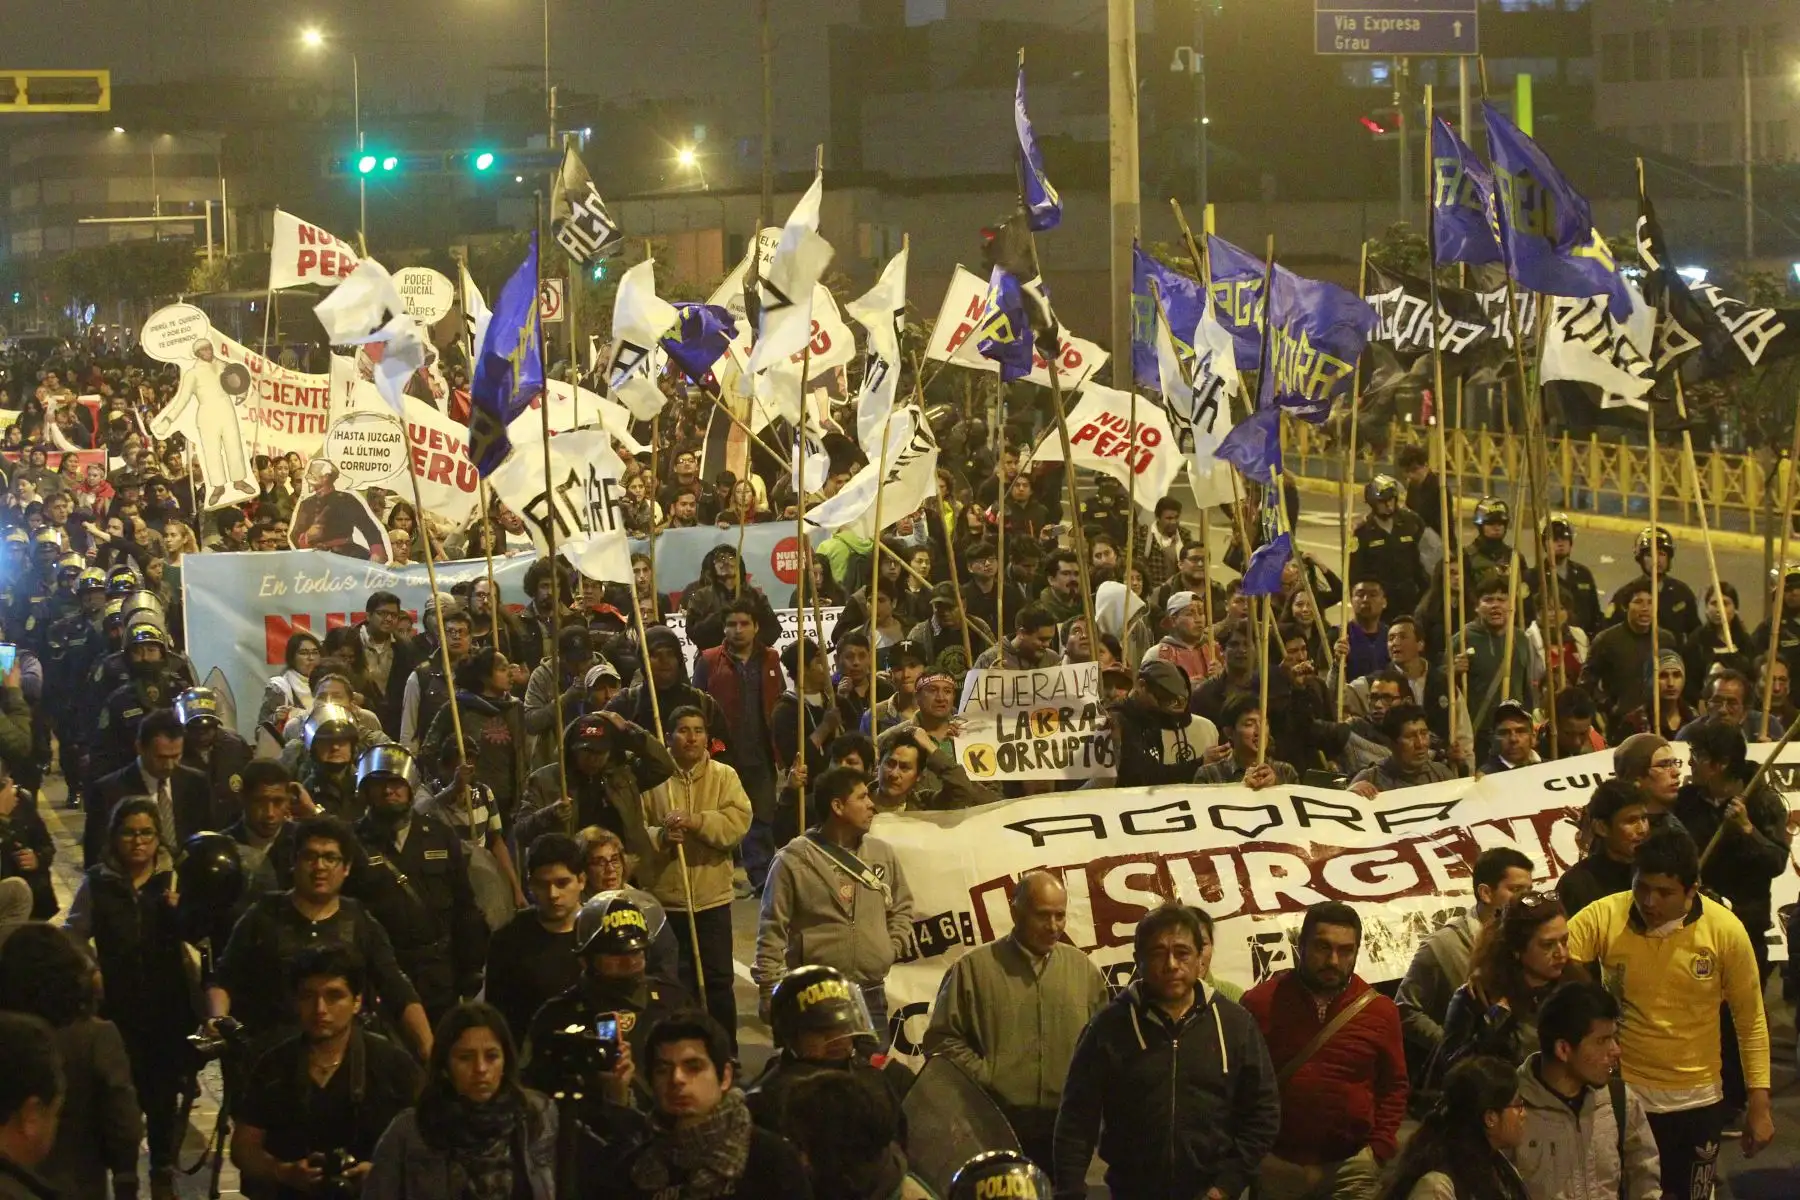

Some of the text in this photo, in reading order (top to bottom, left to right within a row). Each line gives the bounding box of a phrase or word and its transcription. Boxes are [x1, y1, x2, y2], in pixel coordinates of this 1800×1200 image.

[1364, 16, 1421, 33] Expresa
[1335, 34, 1370, 50] Grau
[297, 249, 360, 278] PER
[404, 273, 433, 286] PODER
[400, 285, 434, 296] JUDICIAL
[252, 377, 330, 411] CIENTE
[368, 431, 401, 443] JUZGAR
[408, 423, 471, 461] UEVO
[342, 444, 391, 458] AL ÚLTIMO
[340, 460, 392, 473] CORRUPTO!
[411, 445, 479, 494] ERÚ
[776, 559, 806, 571] PER
[258, 575, 287, 597] En
[294, 570, 357, 595] todas
[363, 567, 398, 590] las
[996, 702, 1108, 744] LAKRA
[1003, 799, 1464, 848] AGORA
[603, 909, 648, 933] POLICIA
